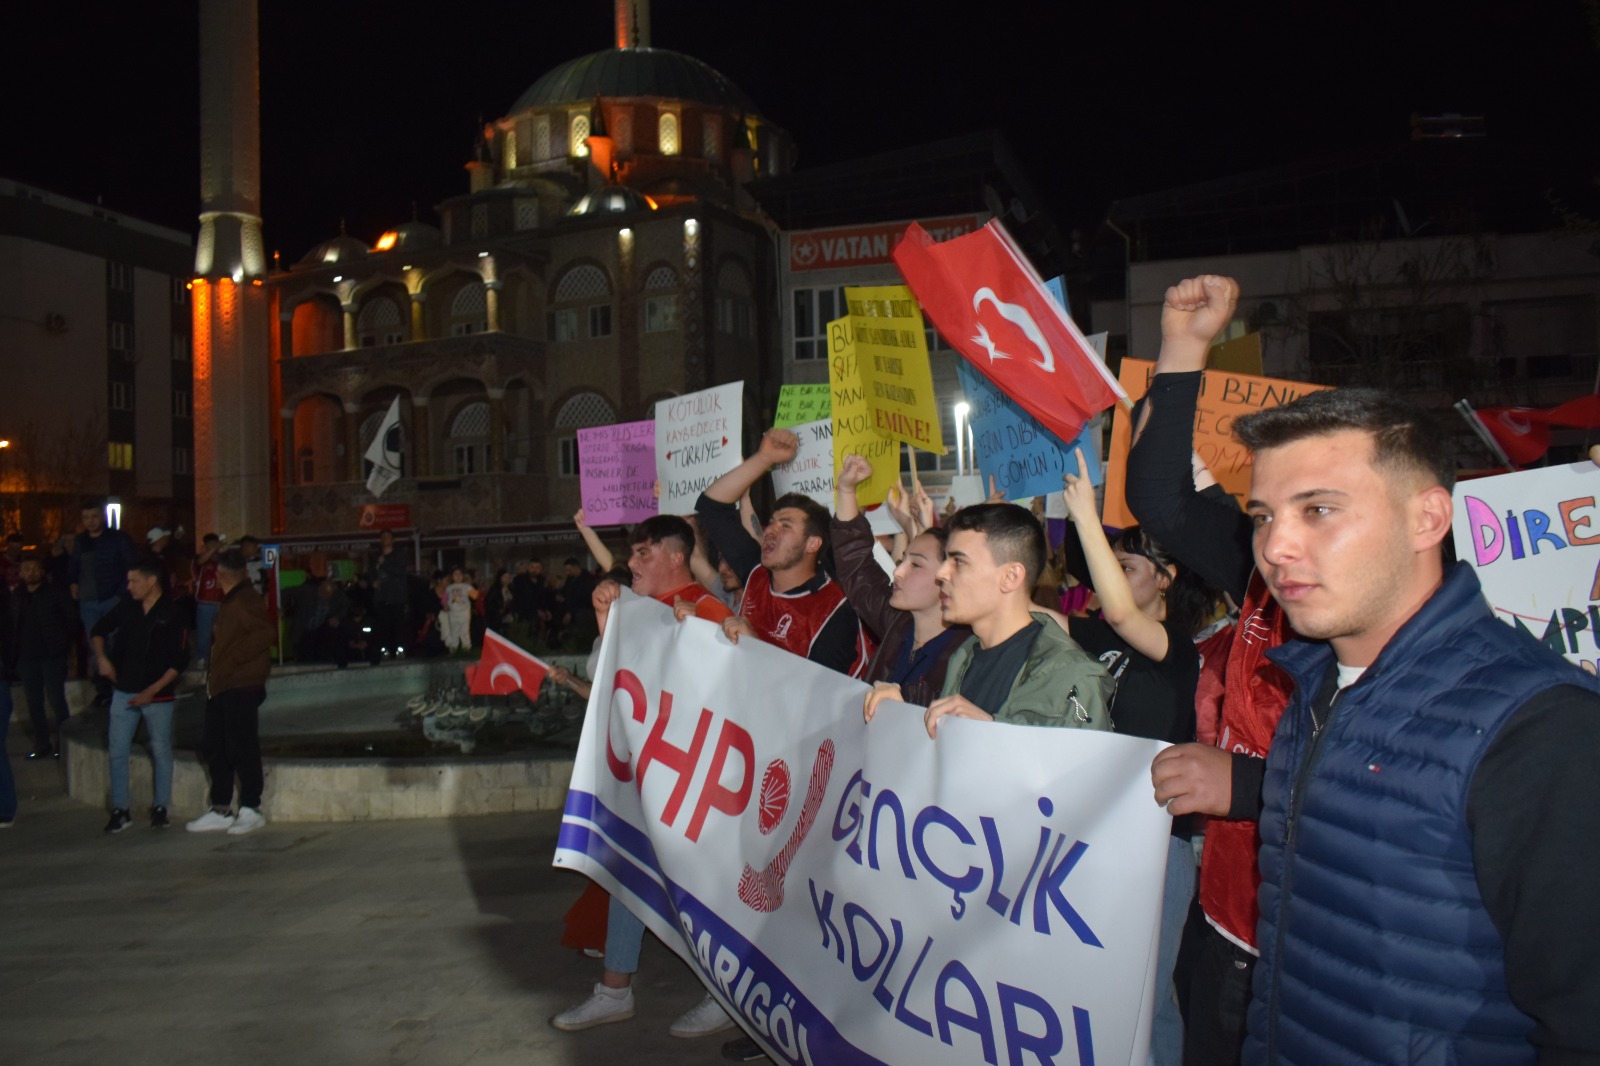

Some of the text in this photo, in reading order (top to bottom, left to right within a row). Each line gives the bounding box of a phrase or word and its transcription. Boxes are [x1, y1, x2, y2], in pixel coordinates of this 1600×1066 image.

[820, 233, 889, 262] VATAN
[668, 391, 722, 422] KÖTÜLÜK
[1223, 378, 1303, 407] BENİ
[666, 416, 727, 444] KAYBEDECEK
[875, 407, 930, 444] EMİNE!
[671, 439, 722, 467] TÜRKİYE
[1464, 496, 1600, 568] DİRE
[606, 668, 756, 843] CHP
[831, 768, 1105, 949] GENÇLİK
[808, 877, 1096, 1066] KOLLARI
